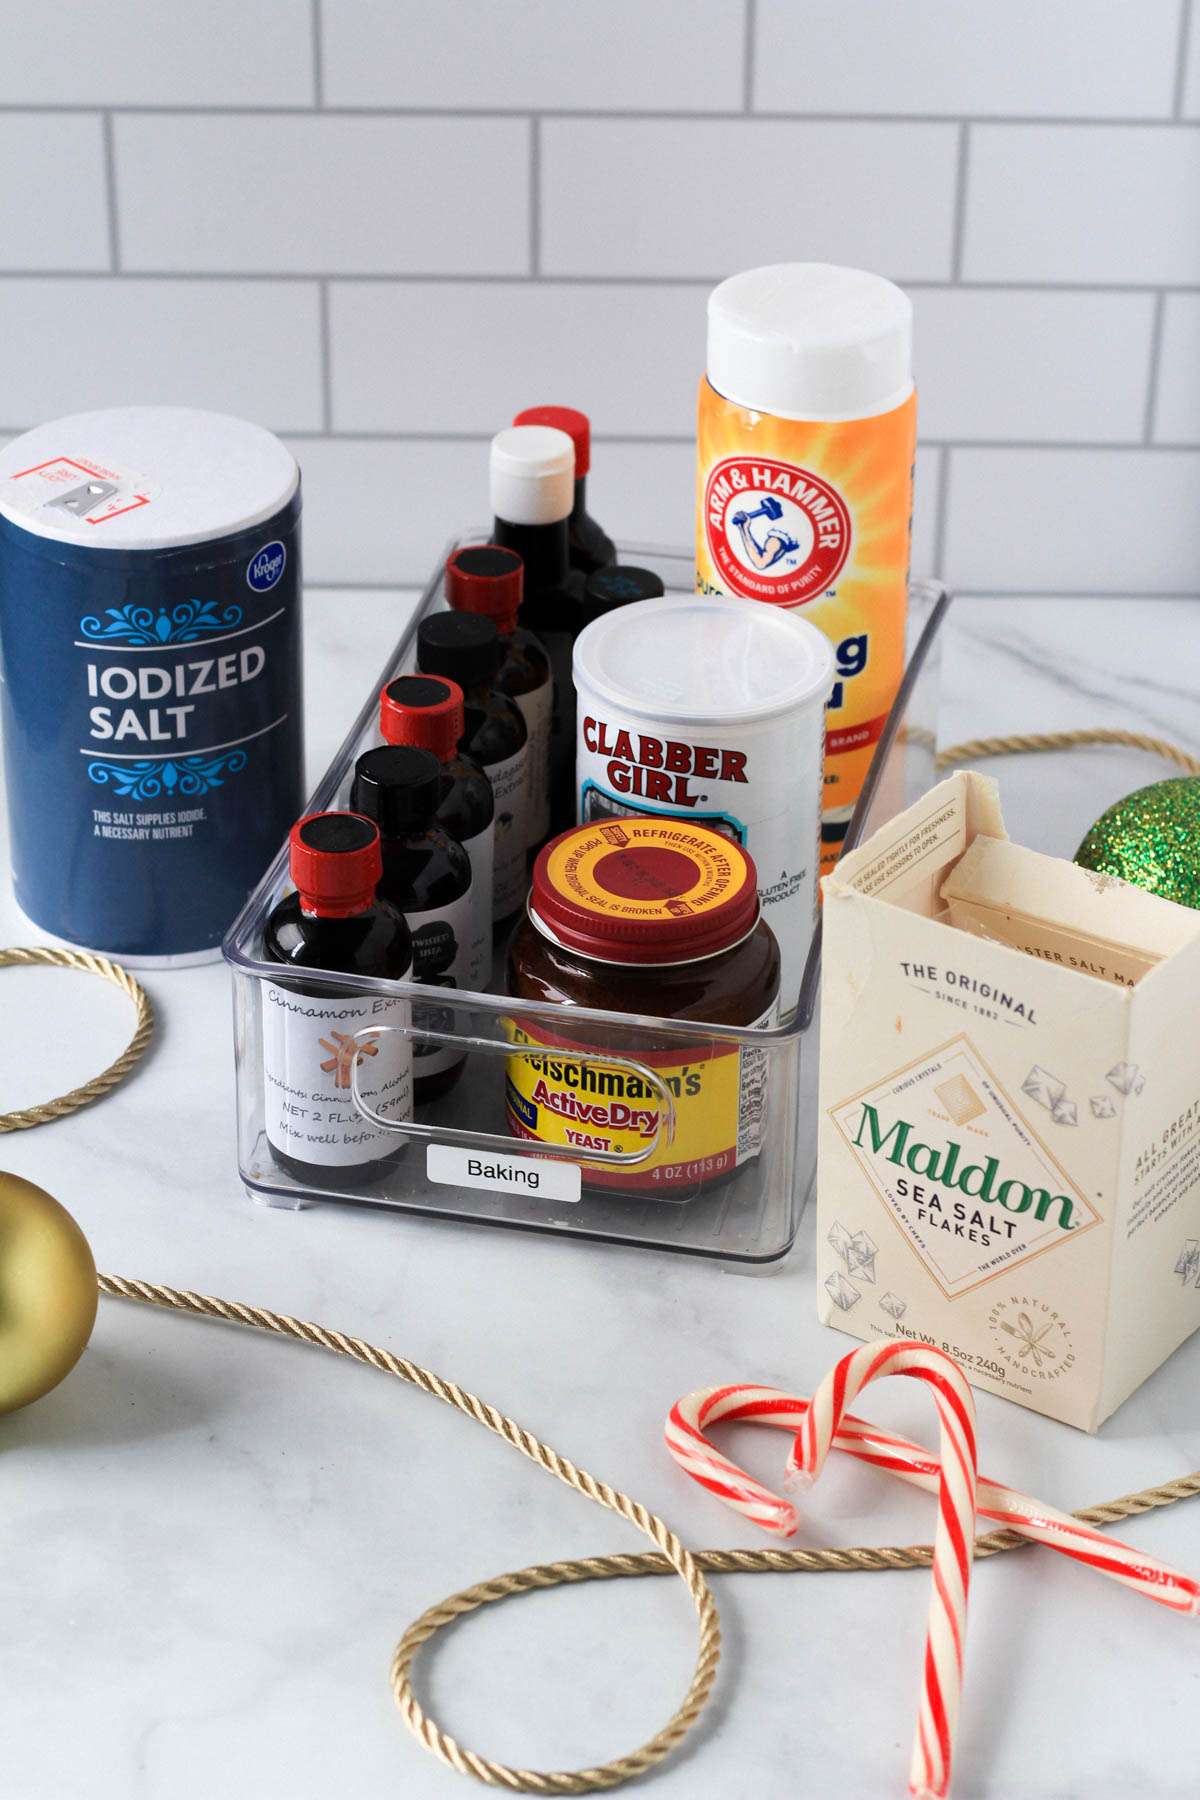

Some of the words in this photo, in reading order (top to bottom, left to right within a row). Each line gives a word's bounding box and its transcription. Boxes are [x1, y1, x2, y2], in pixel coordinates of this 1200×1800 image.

[709, 476, 733, 532] ARM
[730, 467, 750, 489] &
[751, 467, 841, 550] HAMMER
[253, 554, 282, 581] Kroger
[718, 546, 730, 565] THE
[728, 564, 775, 594] STANDARD
[777, 584, 790, 595] OF
[790, 564, 823, 591] PURITY
[87, 646, 266, 700] IODIZED
[89, 705, 195, 741] SALT
[583, 716, 749, 783] CLABBER
[830, 730, 870, 749] BRAND
[606, 760, 701, 807] GIRL
[92, 809, 111, 823] THIS
[113, 812, 134, 826] SALT
[136, 812, 176, 826] SUPPLIES
[94, 825, 101, 836] A
[102, 826, 149, 840] NECESSARY
[152, 824, 193, 839] NUTRIENT
[580, 838, 602, 852] POPS
[632, 829, 717, 855] REFRIGERATE
[572, 848, 587, 858] UP
[886, 844, 908, 864] TIGHTLY
[909, 833, 920, 847] FOR
[564, 857, 579, 873] WHEN
[710, 854, 731, 877] AFTER
[781, 870, 787, 880] A
[586, 895, 608, 908] SEAL
[691, 878, 730, 906] OPENING
[762, 883, 800, 907] PRODUCT
[621, 906, 662, 915] BROKEN
[1069, 957, 1107, 976] SALT
[268, 989, 369, 1019] Cinnamon
[900, 962, 937, 980] THE
[945, 970, 1037, 1024] ORIGINAL
[935, 991, 968, 1010] SINCE
[915, 1063, 942, 1082] CRYSTALS
[282, 1102, 309, 1118] NET
[312, 1112, 323, 1122] 2
[279, 1121, 304, 1138] Mix
[306, 1131, 339, 1144] well
[564, 1128, 611, 1152] YEAST
[1135, 1142, 1156, 1169] ALL
[1162, 1100, 1199, 1143] GREAT
[1169, 1122, 1193, 1149] WITH
[467, 1159, 540, 1189] Baking
[652, 1168, 660, 1179] 4
[716, 1153, 728, 1169] g)
[851, 1101, 1075, 1230] Maldon
[884, 1189, 902, 1213] LOVED
[908, 1225, 926, 1249] CHEFS
[896, 1178, 942, 1212] SEA
[953, 1203, 1017, 1239] SALT
[918, 1209, 991, 1247] FLAKES
[978, 1262, 991, 1272] THE
[991, 1252, 1011, 1266] WORLD
[1012, 1244, 1027, 1255] OVER
[870, 1323, 883, 1334] This
[1010, 1296, 1071, 1338] NATURAL
[895, 1322, 918, 1339] Net
[942, 1342, 974, 1363] 8.5oz
[976, 1355, 1005, 1378] 240g
[997, 1346, 1076, 1380] HANDCRAFTED
[974, 1367, 1006, 1385] necessary
[1006, 1379, 1033, 1395] nutrient
